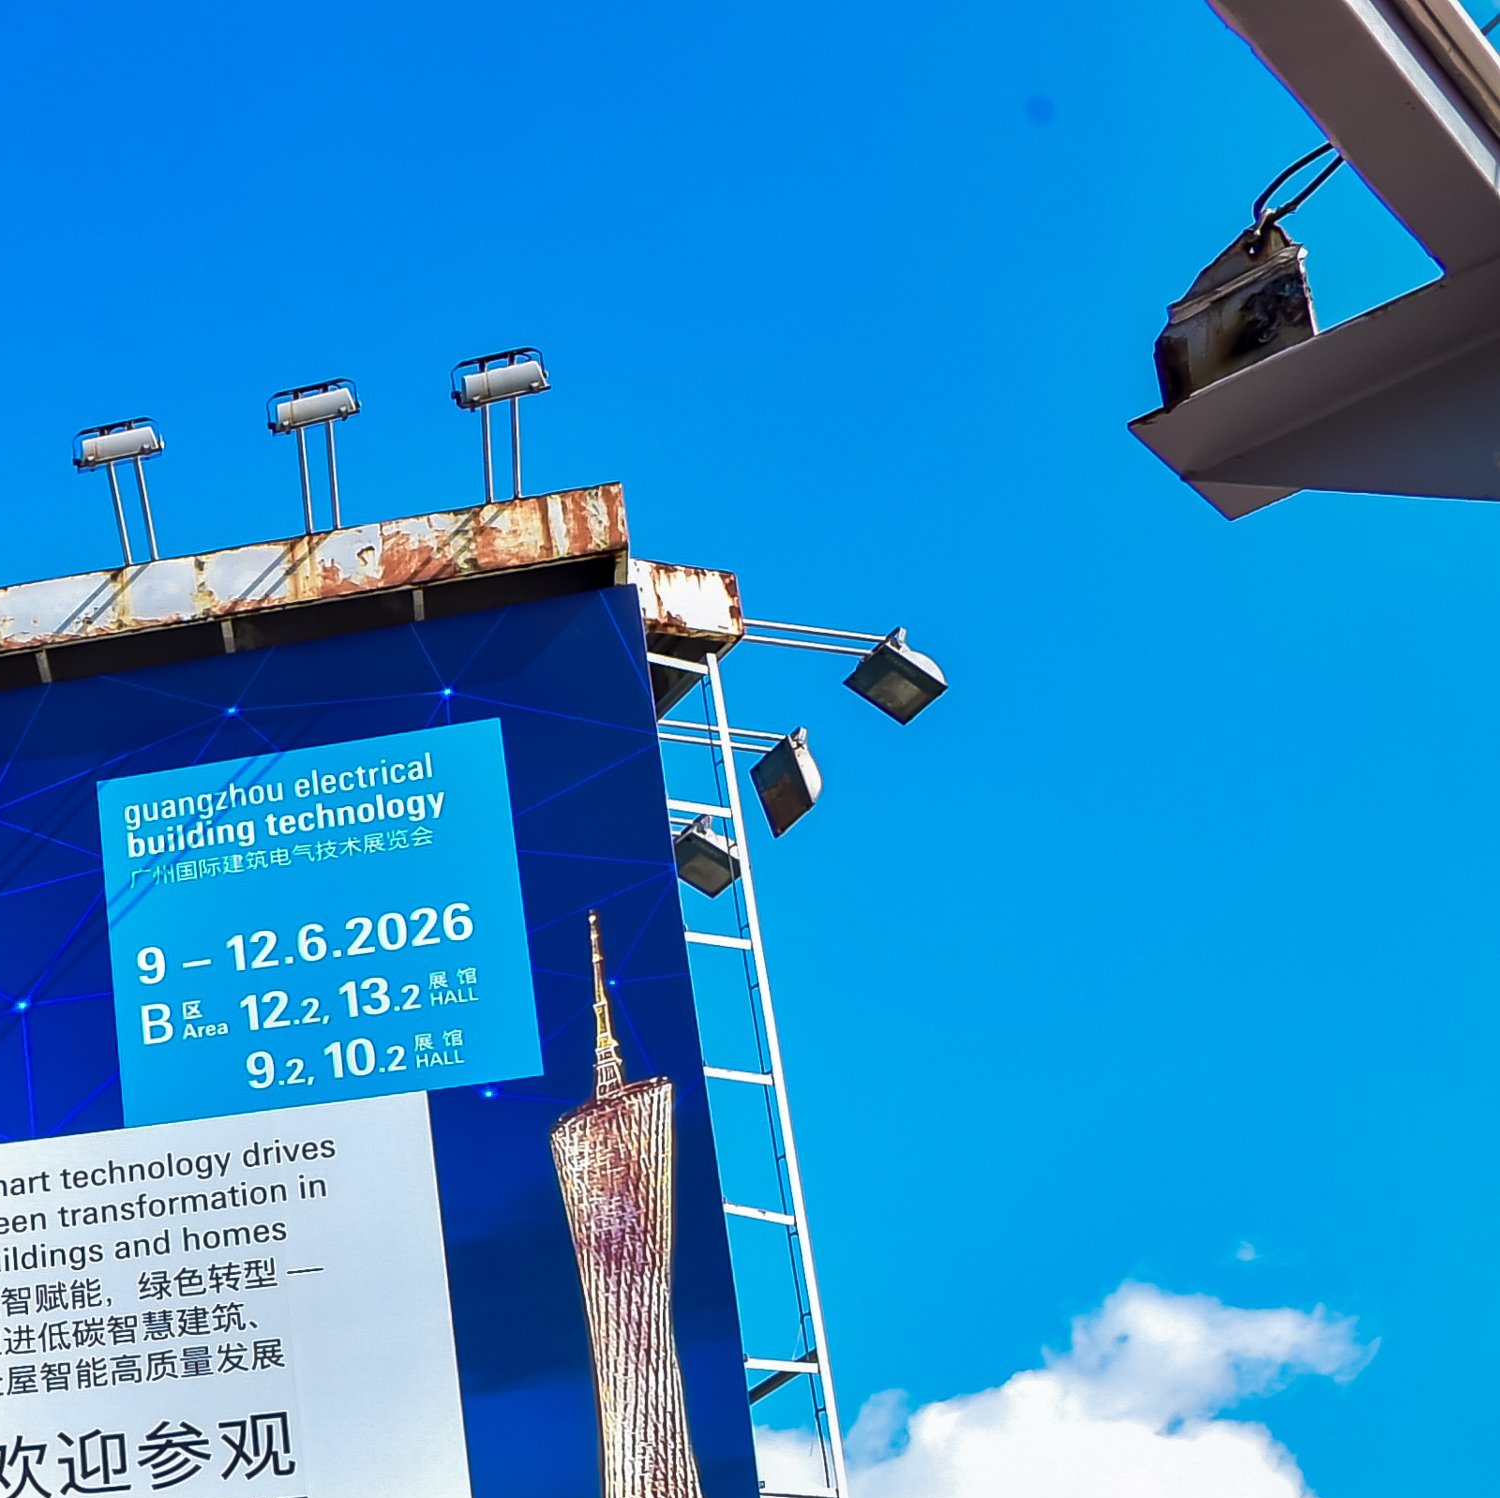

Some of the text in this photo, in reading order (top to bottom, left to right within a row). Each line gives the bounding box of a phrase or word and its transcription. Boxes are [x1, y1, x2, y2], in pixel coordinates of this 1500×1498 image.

[124, 752, 433, 830] guangzhou electrical
[127, 792, 445, 858] building technology
[130, 826, 434, 889] 广州国际建筑电气技术展览会
[137, 947, 166, 984] 9
[226, 902, 474, 971] 12.6.2026
[183, 1000, 203, 1019] 区
[338, 977, 421, 1018] 13.2
[430, 987, 479, 1007] HALL
[140, 1003, 174, 1045] B
[183, 1022, 228, 1040] Area
[323, 1038, 407, 1078] 10.2
[416, 1049, 465, 1068] HALL
[60, 1151, 232, 1191] technology
[242, 1136, 337, 1168] drives
[57, 1182, 287, 1229] transformation
[298, 1174, 327, 1200] in
[114, 1230, 171, 1261] and
[182, 1222, 287, 1253] homes
